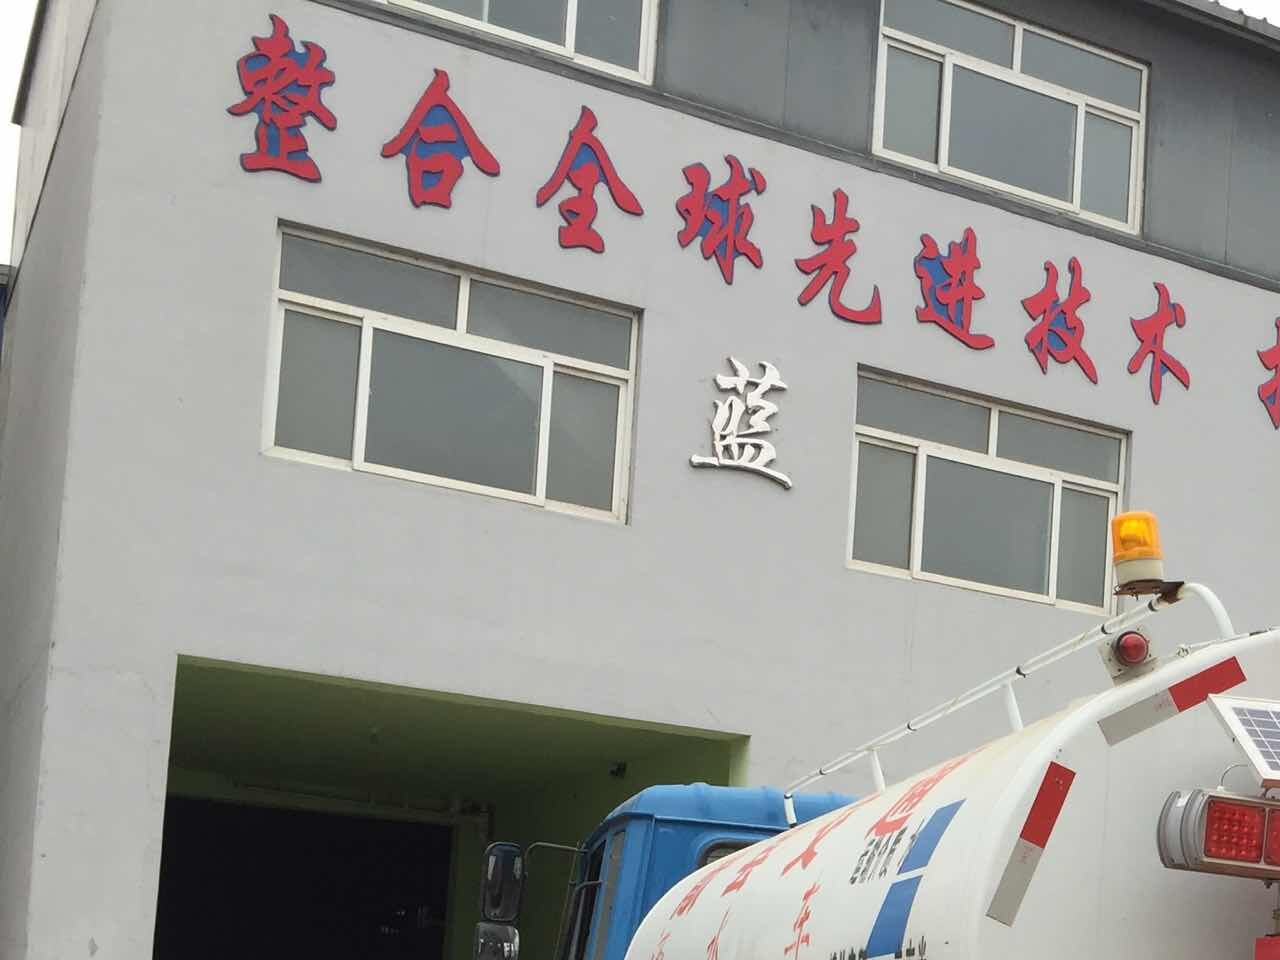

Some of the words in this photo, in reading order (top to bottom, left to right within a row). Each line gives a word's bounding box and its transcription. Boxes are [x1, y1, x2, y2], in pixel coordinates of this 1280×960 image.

[226, 14, 1190, 405] 整合全球先进技术
[690, 356, 793, 491] 蓝
